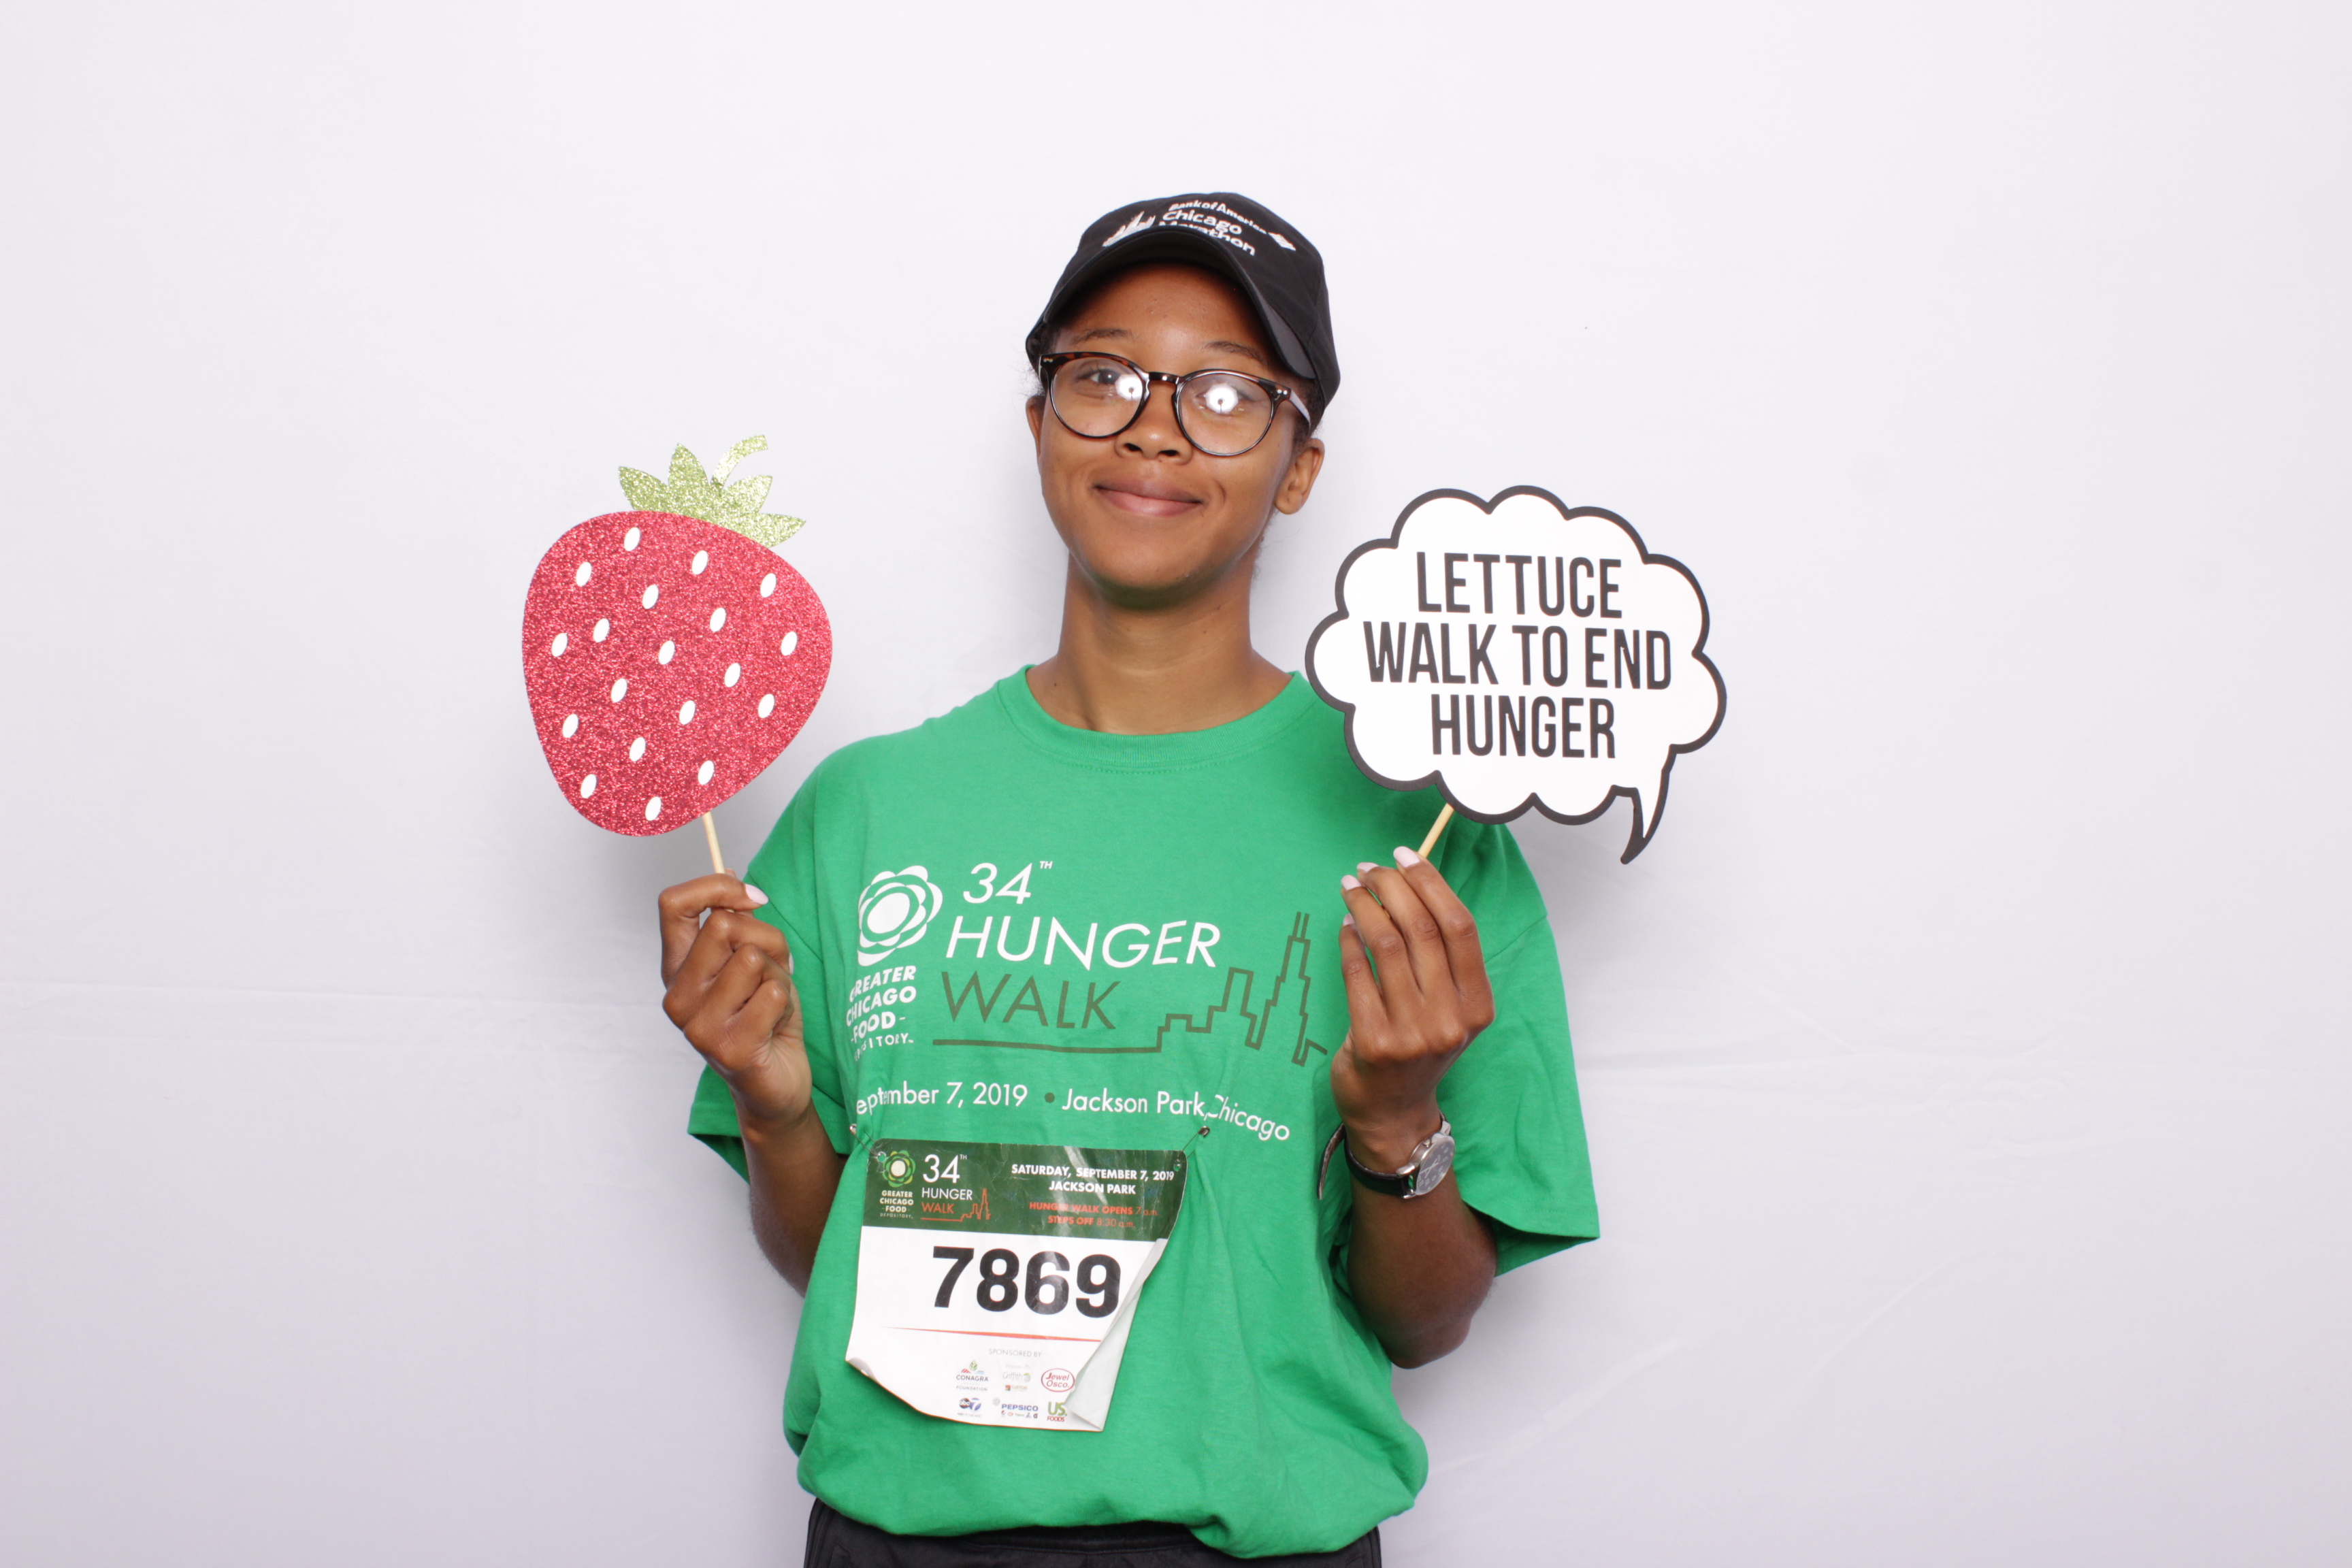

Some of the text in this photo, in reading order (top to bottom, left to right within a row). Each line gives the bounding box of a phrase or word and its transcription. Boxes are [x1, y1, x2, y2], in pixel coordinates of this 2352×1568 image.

[1162, 209, 1242, 235] Chicago
[1215, 203, 1267, 235] America
[1416, 551, 1622, 619] LETTUCE
[1362, 621, 1671, 690] WALK TO END
[1431, 693, 1616, 759] HUNGER
[946, 915, 1221, 970] HUNGER
[846, 985, 916, 1027] CHICAGO
[941, 970, 1121, 1030] WALK
[855, 1081, 939, 1115] eptember
[947, 1081, 964, 1108] 7,
[973, 1081, 1028, 1107] 2019
[1062, 1088, 1148, 1113] Jackson
[1157, 1090, 1208, 1121] Park,
[1011, 1164, 1175, 1181] SATURDAY, SEPTEMBER 7, 2019
[881, 1190, 913, 1198] GREATER
[921, 1187, 973, 1200] HUNGER
[1049, 1181, 1137, 1194] JACKSON PARK
[879, 1198, 914, 1206] CHICAGO
[921, 1202, 954, 1213] WALK
[1029, 1202, 1069, 1211] HUNGER
[1072, 1204, 1099, 1213] WALK
[1102, 1205, 1133, 1215] OPENS
[1135, 1207, 1142, 1215] 7
[1047, 1215, 1075, 1224] STEPS
[1076, 1217, 1094, 1226] OFF
[1096, 1218, 1117, 1227] 8:30
[932, 1245, 1122, 1318] 7869
[989, 1348, 1032, 1357] SPONSORED
[956, 1374, 989, 1382] CONAGRA
[1002, 1371, 1023, 1381] Griffith
[1045, 1372, 1070, 1381] Jewel
[1002, 1403, 1039, 1411] PEPSICO
